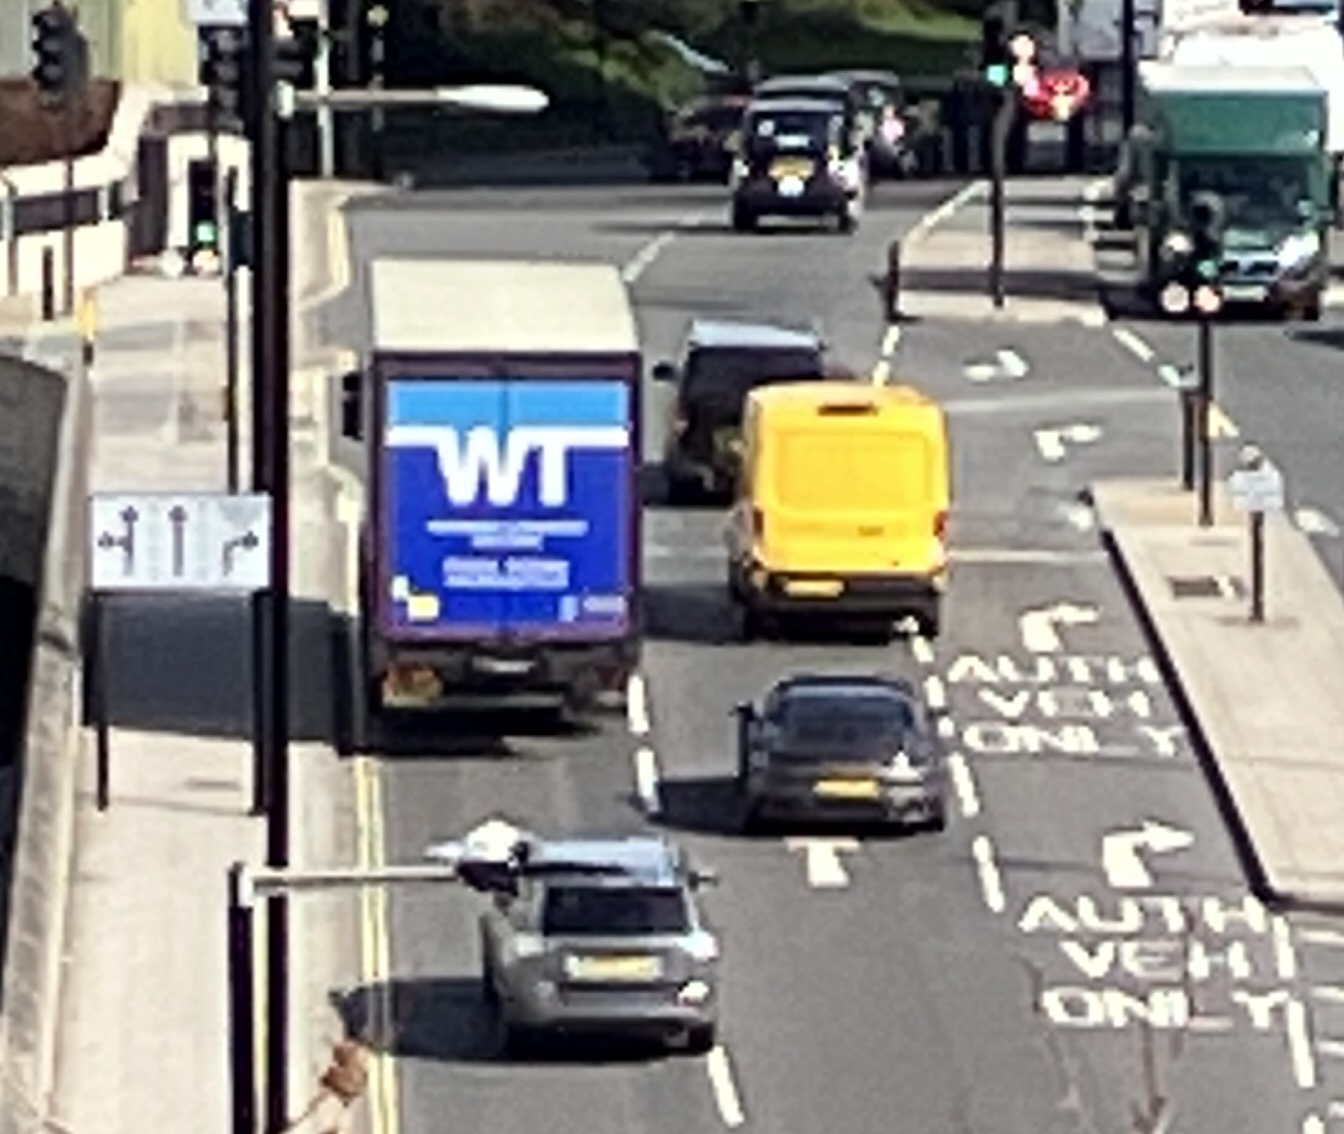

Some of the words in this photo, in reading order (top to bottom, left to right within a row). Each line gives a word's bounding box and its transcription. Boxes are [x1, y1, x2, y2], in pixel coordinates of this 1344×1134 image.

[385, 425, 627, 507] WT
[948, 656, 1162, 683] AUTH
[980, 689, 1152, 718] VEH
[962, 725, 1187, 757] ONLY
[1017, 896, 1268, 933] AUTH
[1060, 941, 1250, 979] VEH
[1041, 987, 1290, 1030] ONLY
